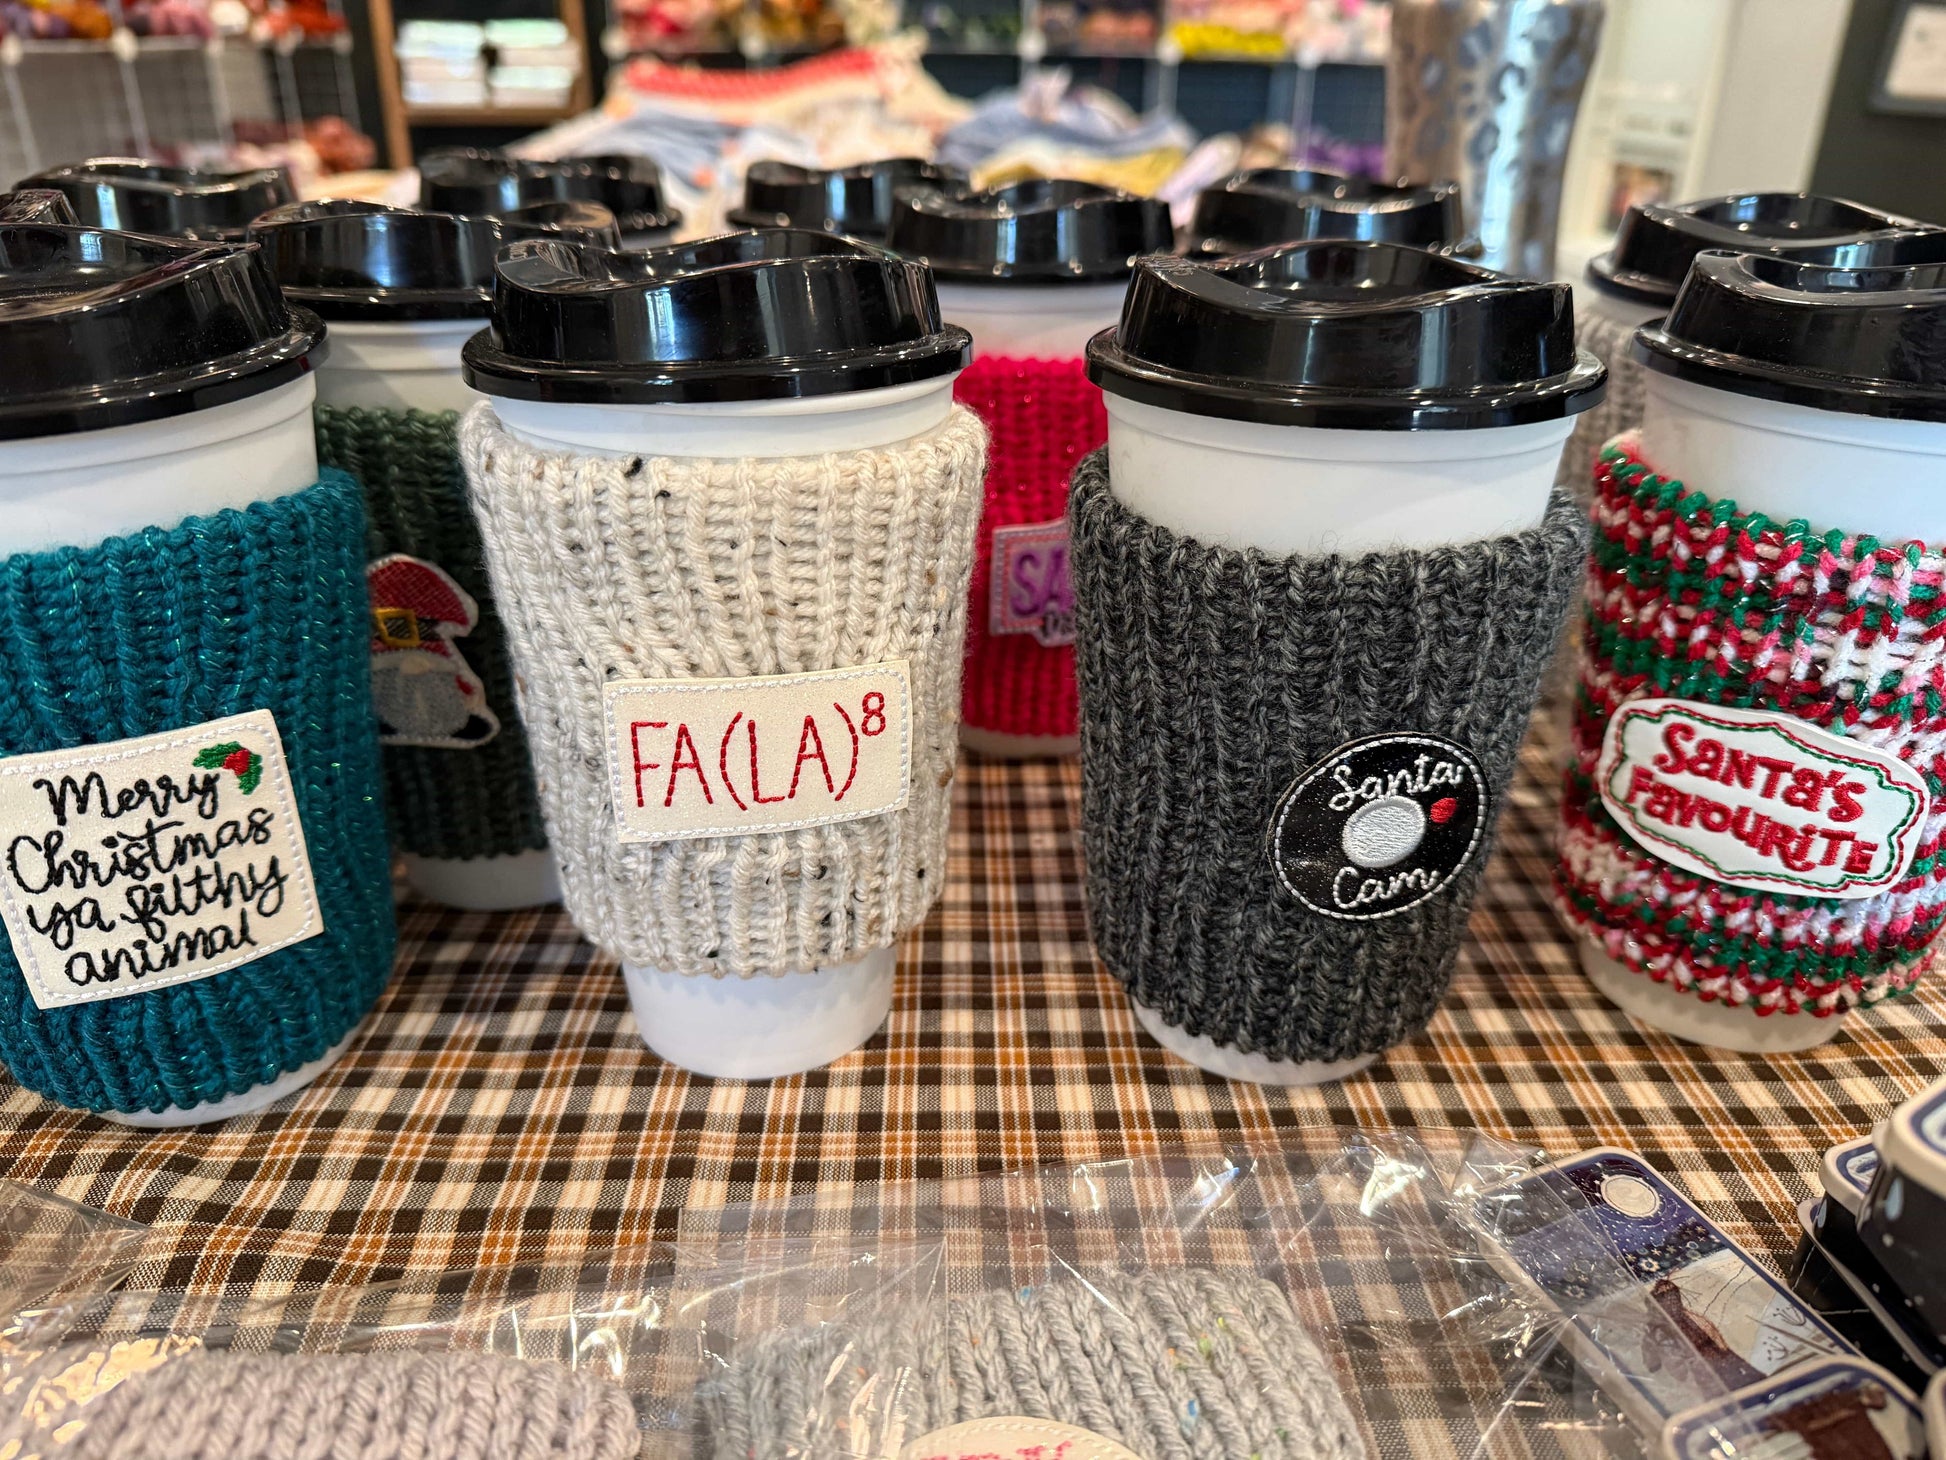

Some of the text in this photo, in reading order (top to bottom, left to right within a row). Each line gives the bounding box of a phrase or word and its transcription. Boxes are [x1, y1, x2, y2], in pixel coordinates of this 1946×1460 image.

[33, 771, 220, 826] Merry
[1328, 753, 1465, 811] Santa
[6, 807, 275, 894] Christmas
[26, 855, 289, 951] ya filthy
[1332, 866, 1441, 909] Cam
[64, 908, 258, 987] animal
